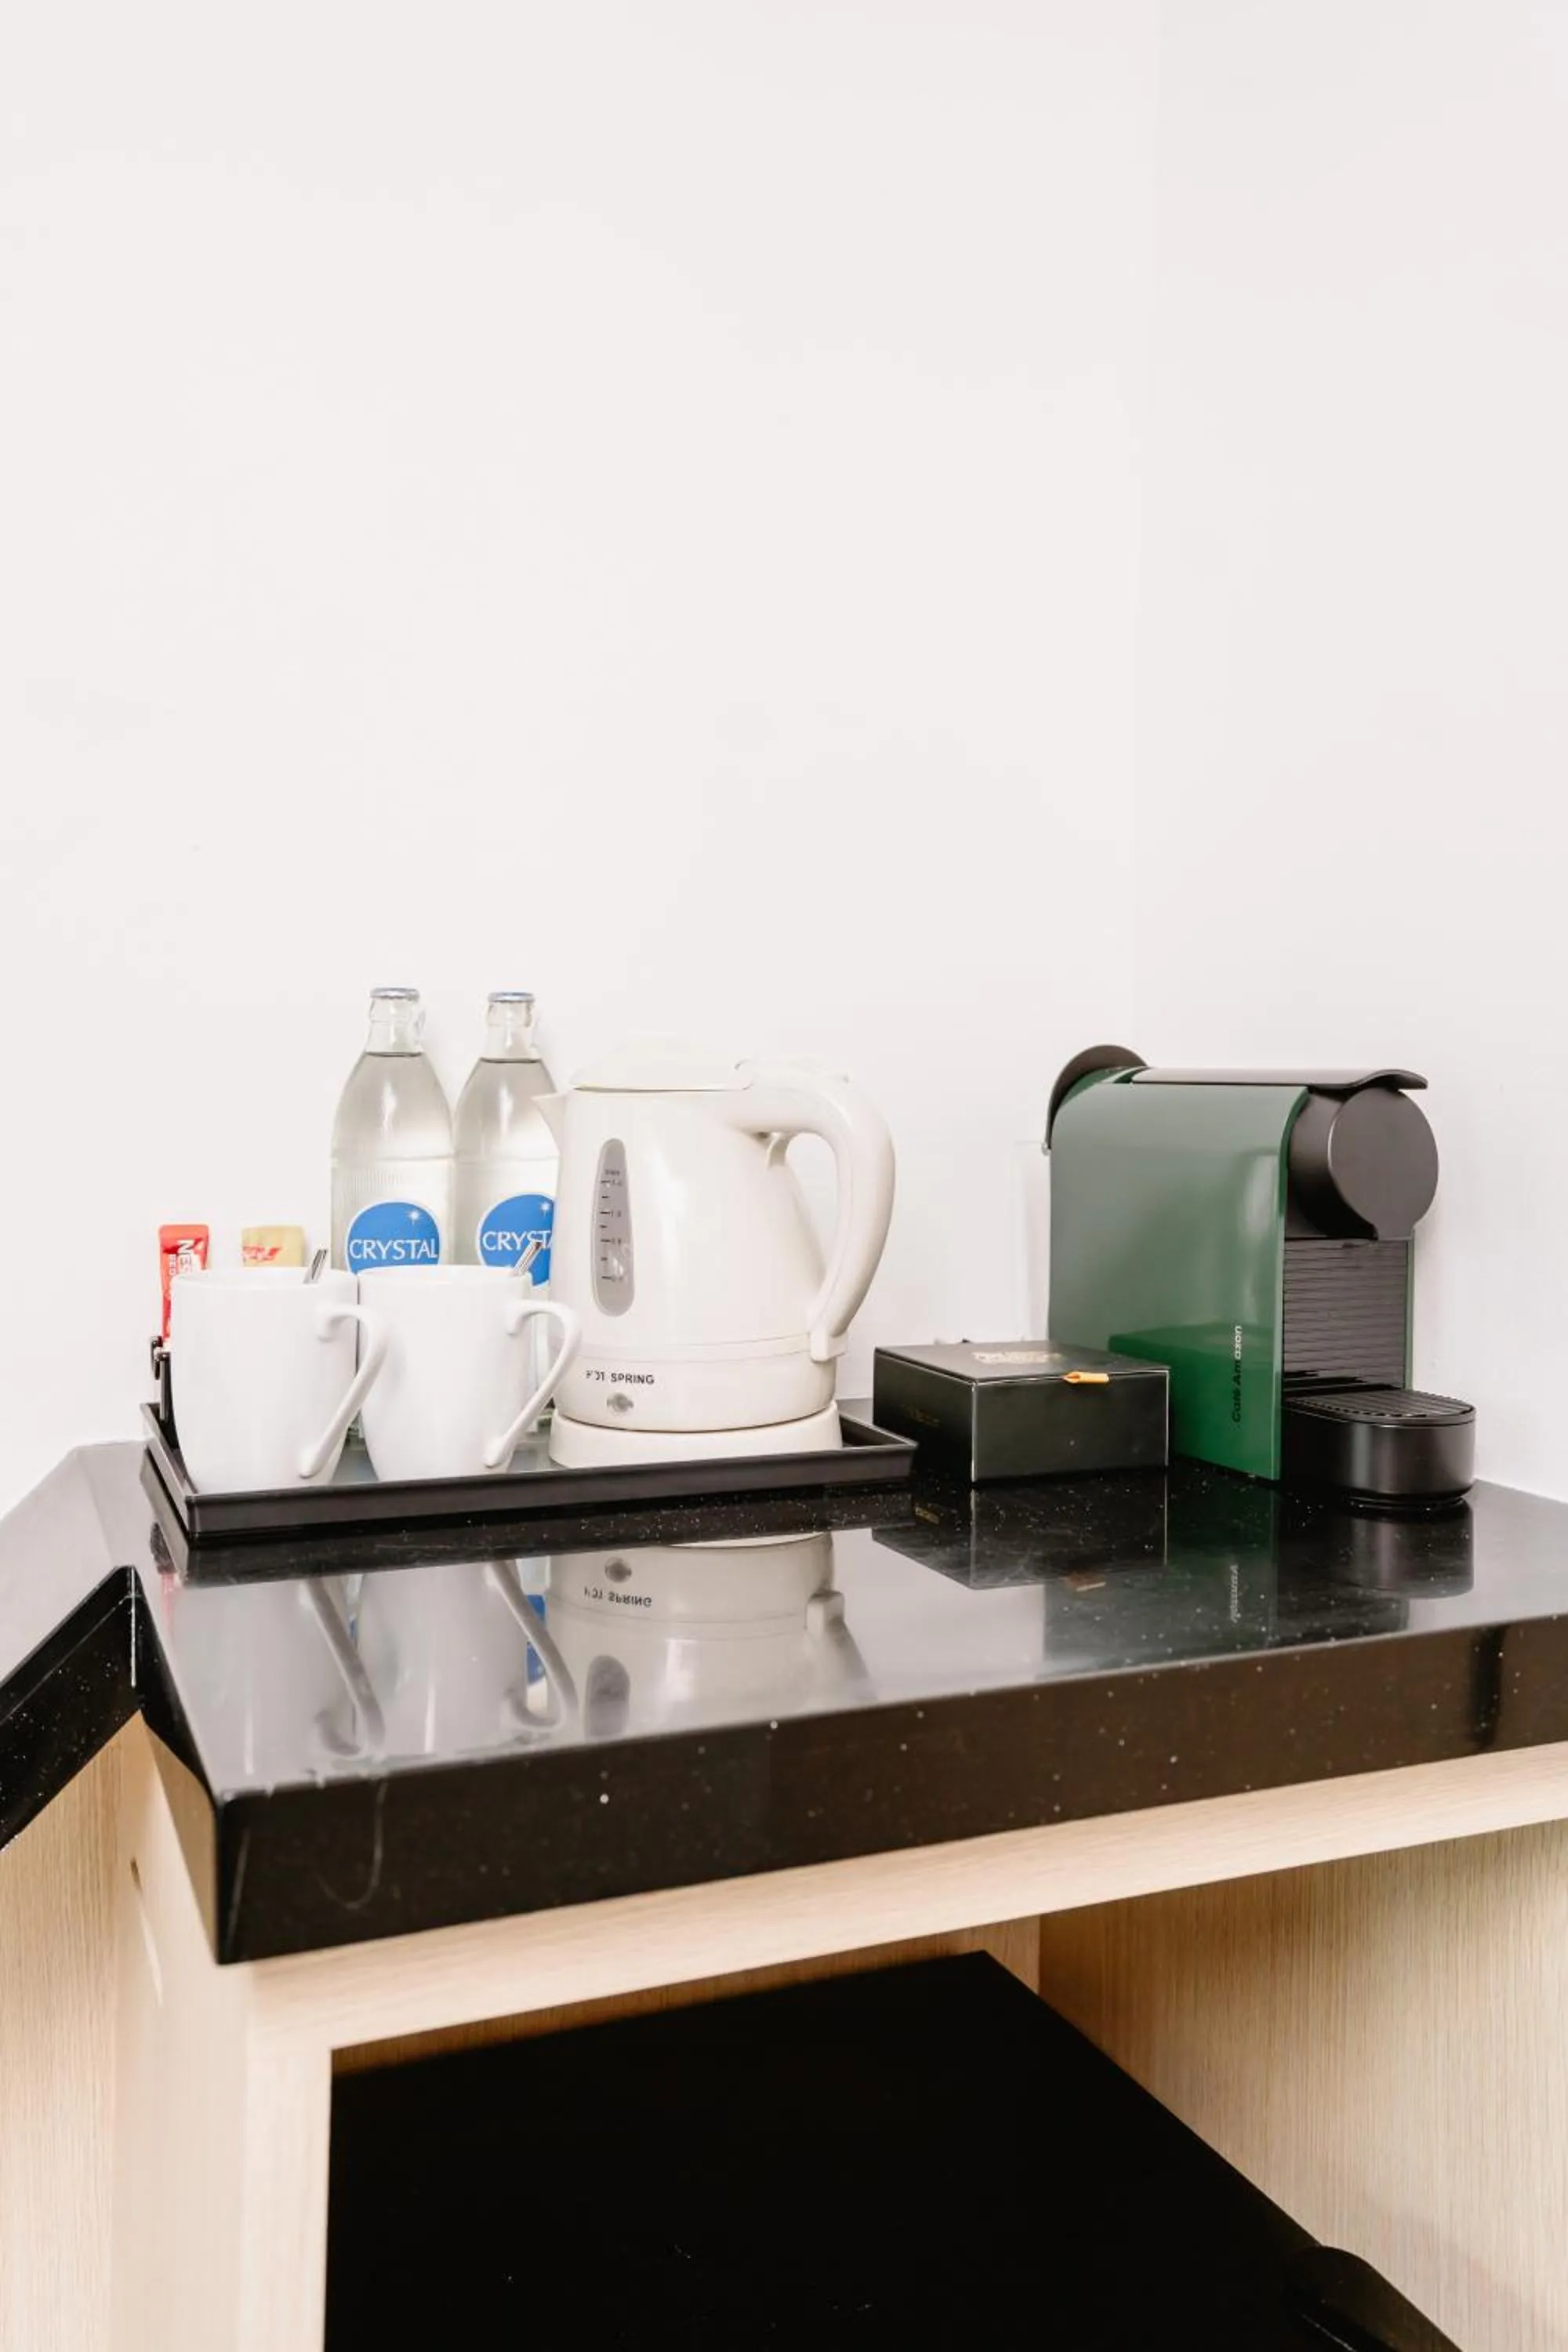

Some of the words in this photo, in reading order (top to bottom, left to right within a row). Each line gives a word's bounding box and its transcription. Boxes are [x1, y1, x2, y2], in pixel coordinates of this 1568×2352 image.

[176, 1240, 194, 1274] NES
[350, 1239, 437, 1260] CRYSTAL
[611, 1373, 654, 1385] SPRING
